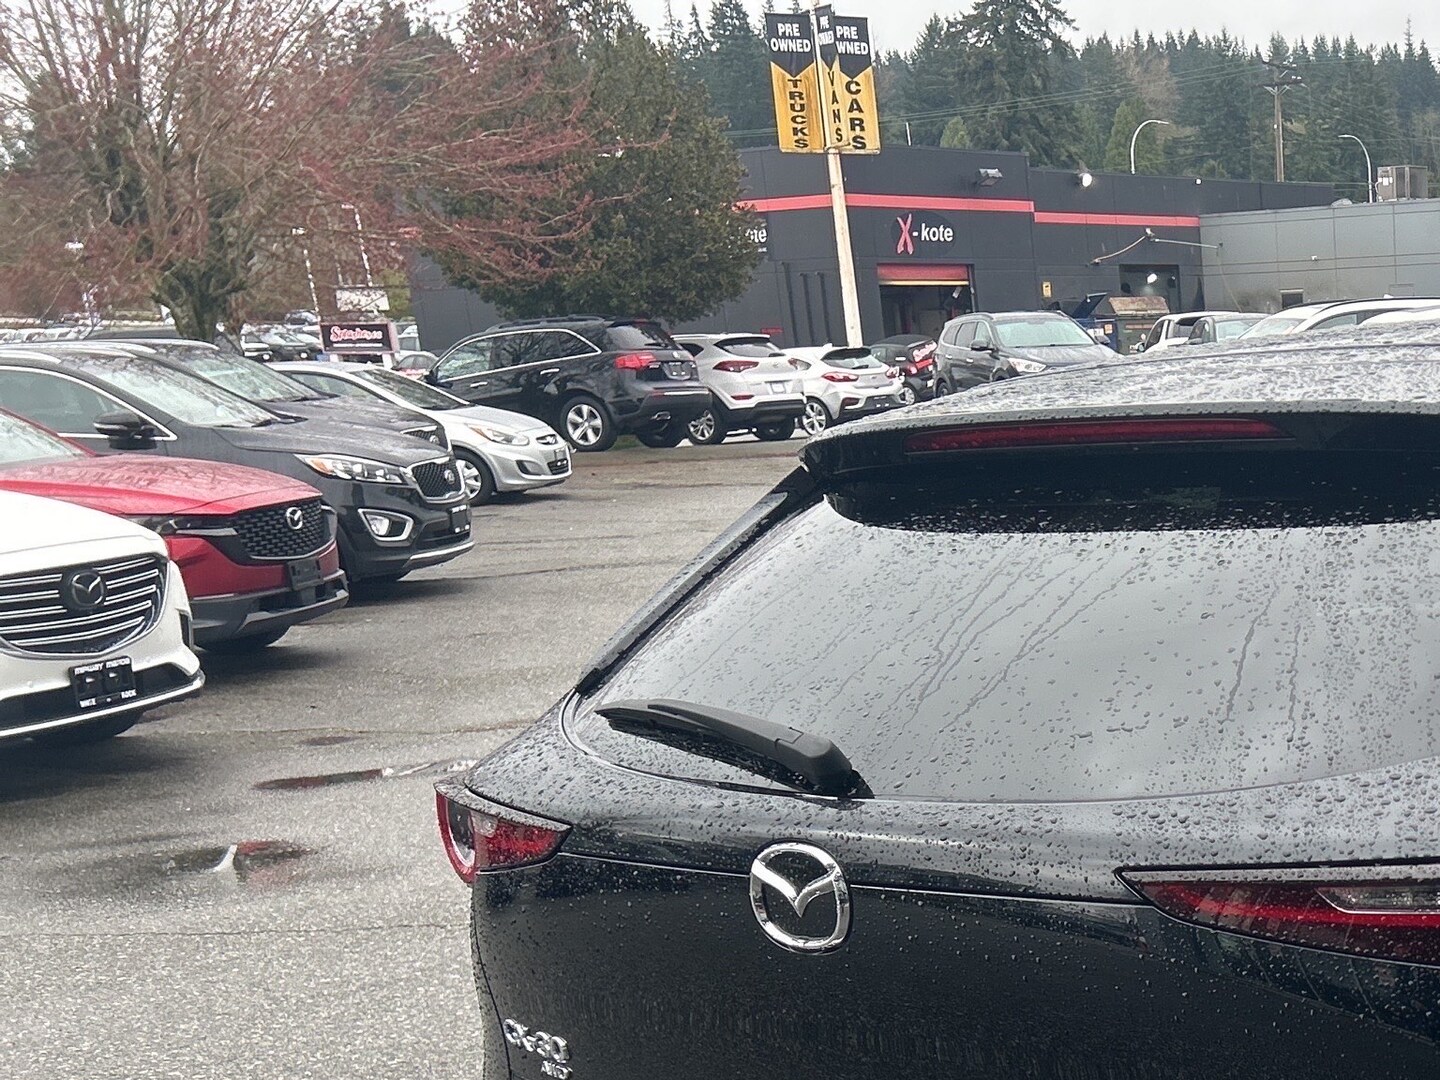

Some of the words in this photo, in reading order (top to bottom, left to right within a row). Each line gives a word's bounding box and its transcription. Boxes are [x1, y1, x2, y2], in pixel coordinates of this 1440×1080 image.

[777, 22, 800, 37] PRE
[836, 25, 859, 39] PRE
[770, 38, 812, 53] OWNED
[835, 40, 869, 55] WNED
[787, 79, 810, 149] TRUCKS
[827, 71, 843, 142] VANS
[844, 80, 867, 150] CARS
